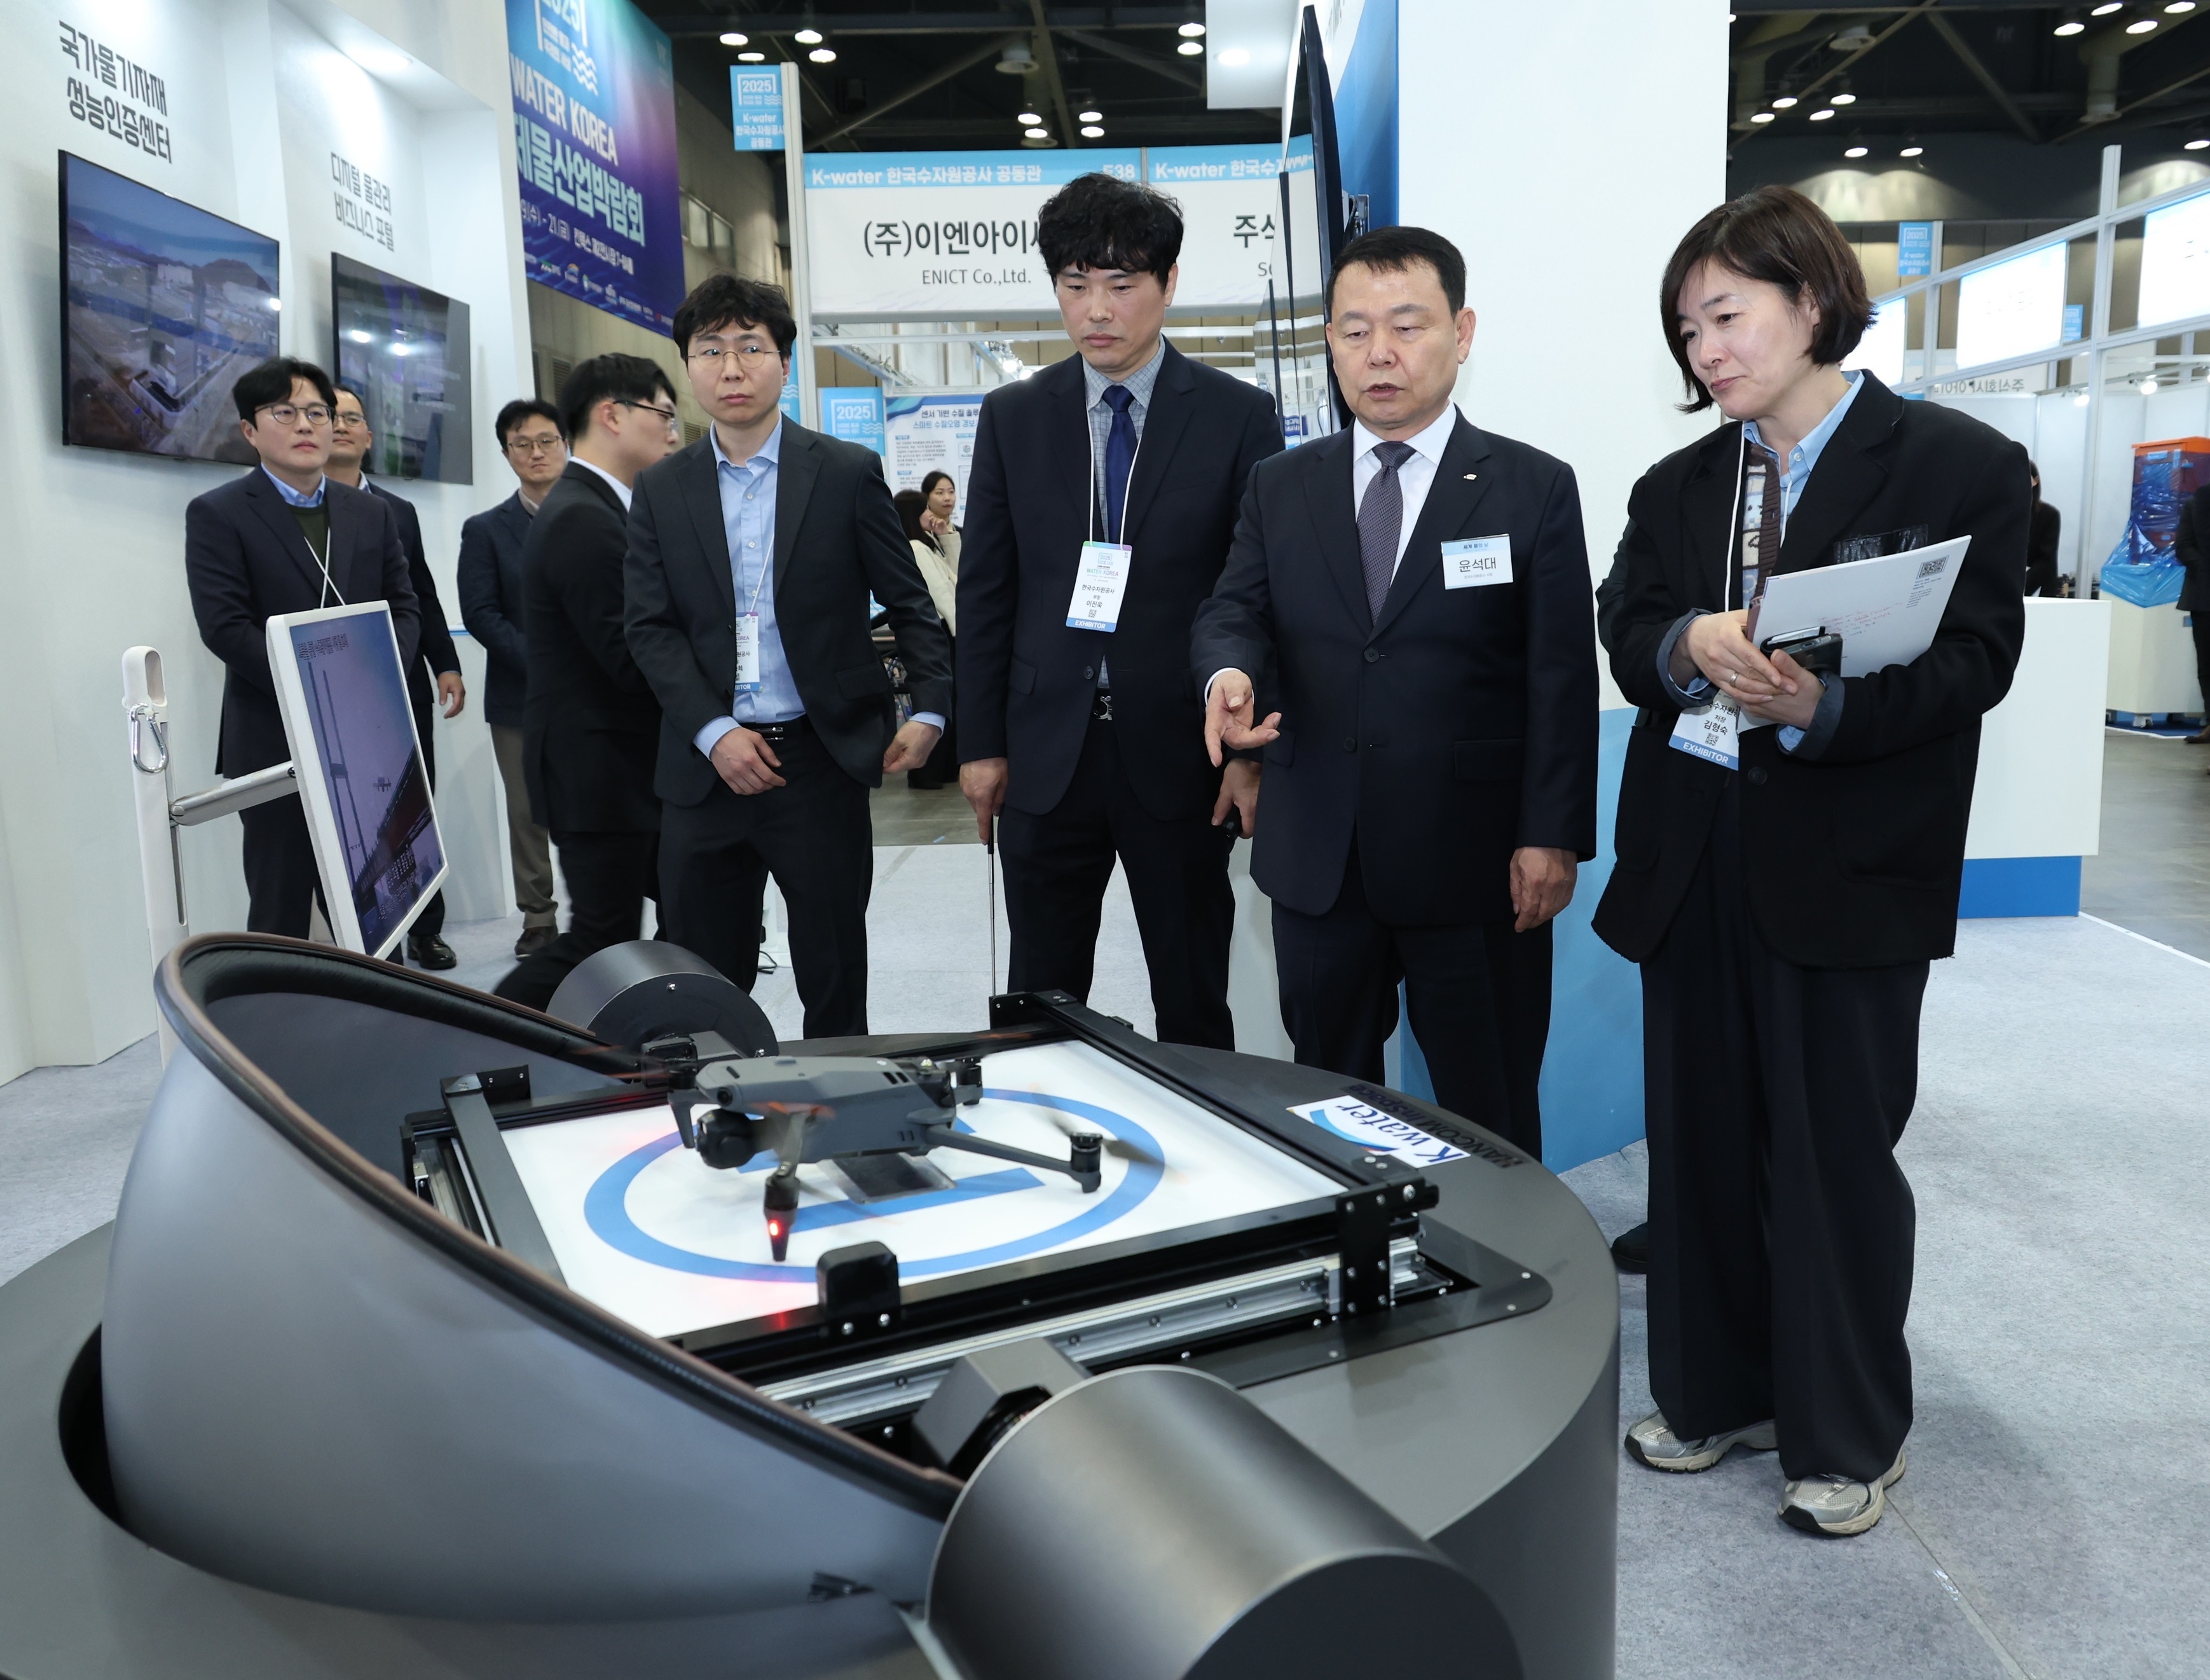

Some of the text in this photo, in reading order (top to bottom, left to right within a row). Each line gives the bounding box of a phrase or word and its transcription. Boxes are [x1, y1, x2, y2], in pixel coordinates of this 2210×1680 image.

[58, 20, 167, 117] 국가물기자재
[742, 79, 772, 92] 2025
[510, 52, 568, 131] WATER
[570, 97, 619, 167] KOREA
[743, 113, 776, 123] K-water
[67, 76, 172, 164] 성능인증센터
[812, 169, 882, 186] K-water
[886, 166, 992, 184] 한국수자원공사
[996, 165, 1041, 182] 공동관
[1155, 162, 1226, 179] K-water
[331, 151, 392, 216] 디지털 물관리
[334, 191, 395, 252] 비즈니스 포털
[923, 268, 1031, 286] ENICT Co.,Ltd.
[836, 405, 871, 420] 2025
[1459, 556, 1496, 572] 윤석대
[1081, 584, 1115, 595] 한국수자원공사
[1074, 619, 1106, 630] EXHIBITOR
[1704, 720, 1728, 735] 김형숙
[1683, 741, 1729, 764] EXHIBITOR
[1418, 1120, 1523, 1169] HANCOM
